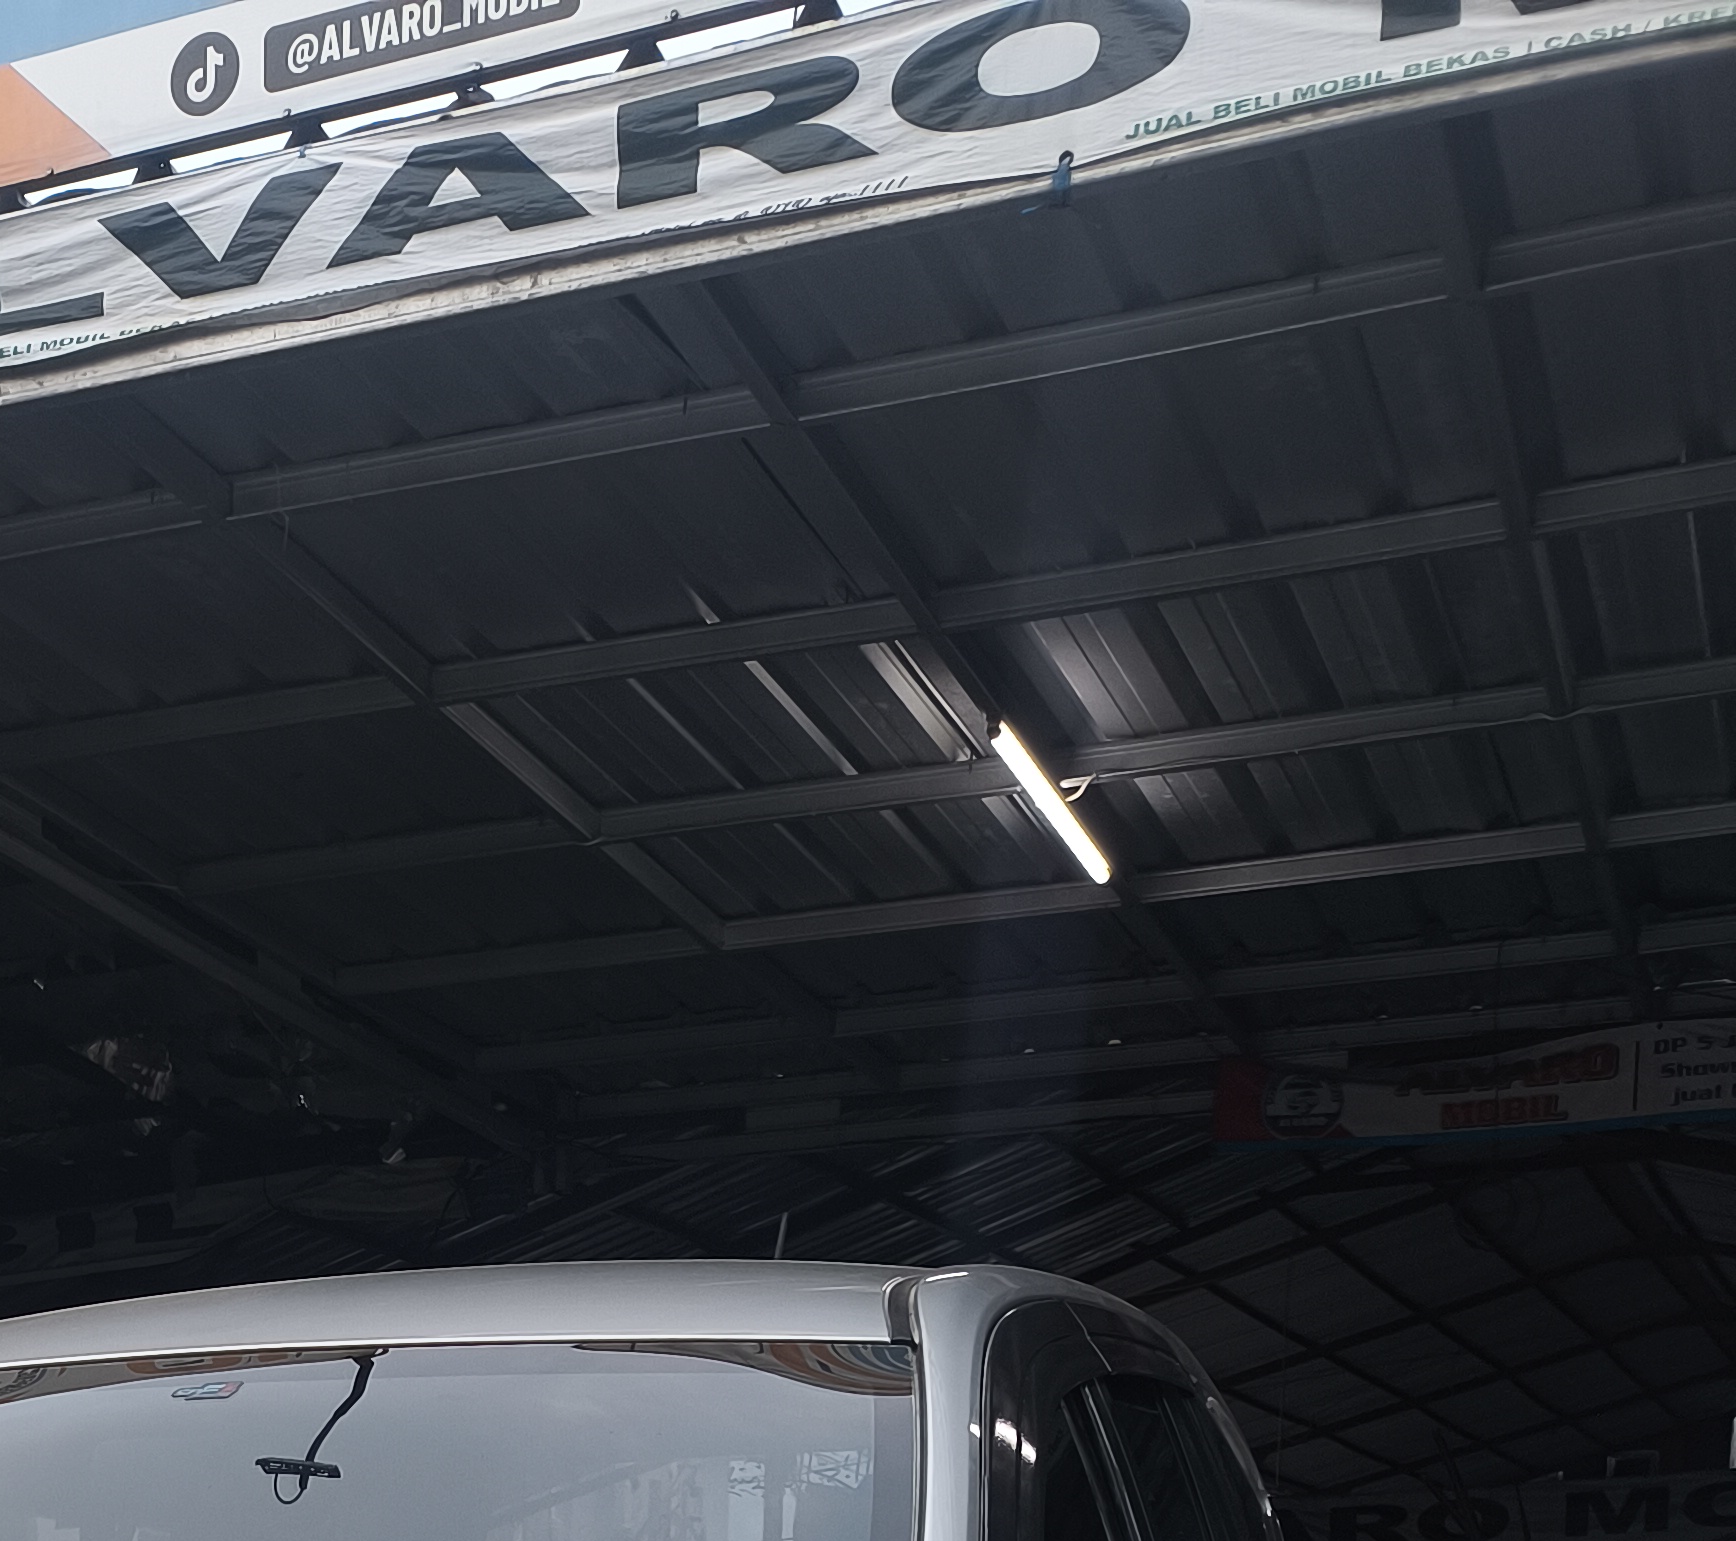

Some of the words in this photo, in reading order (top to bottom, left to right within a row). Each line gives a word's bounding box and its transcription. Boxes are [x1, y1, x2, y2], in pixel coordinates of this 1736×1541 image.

[287, 0, 561, 74] @ALVARO_MO
[1125, 112, 1202, 140] JUAL
[1214, 92, 1281, 120] BELI
[1293, 70, 1392, 101] MOBIL
[1402, 46, 1510, 79] BEKAS
[1544, 23, 1632, 49] CASH
[1664, 3, 1736, 29] KRE
[1660, 1062, 1736, 1078] Show
[1440, 1093, 1568, 1130] MOBIL
